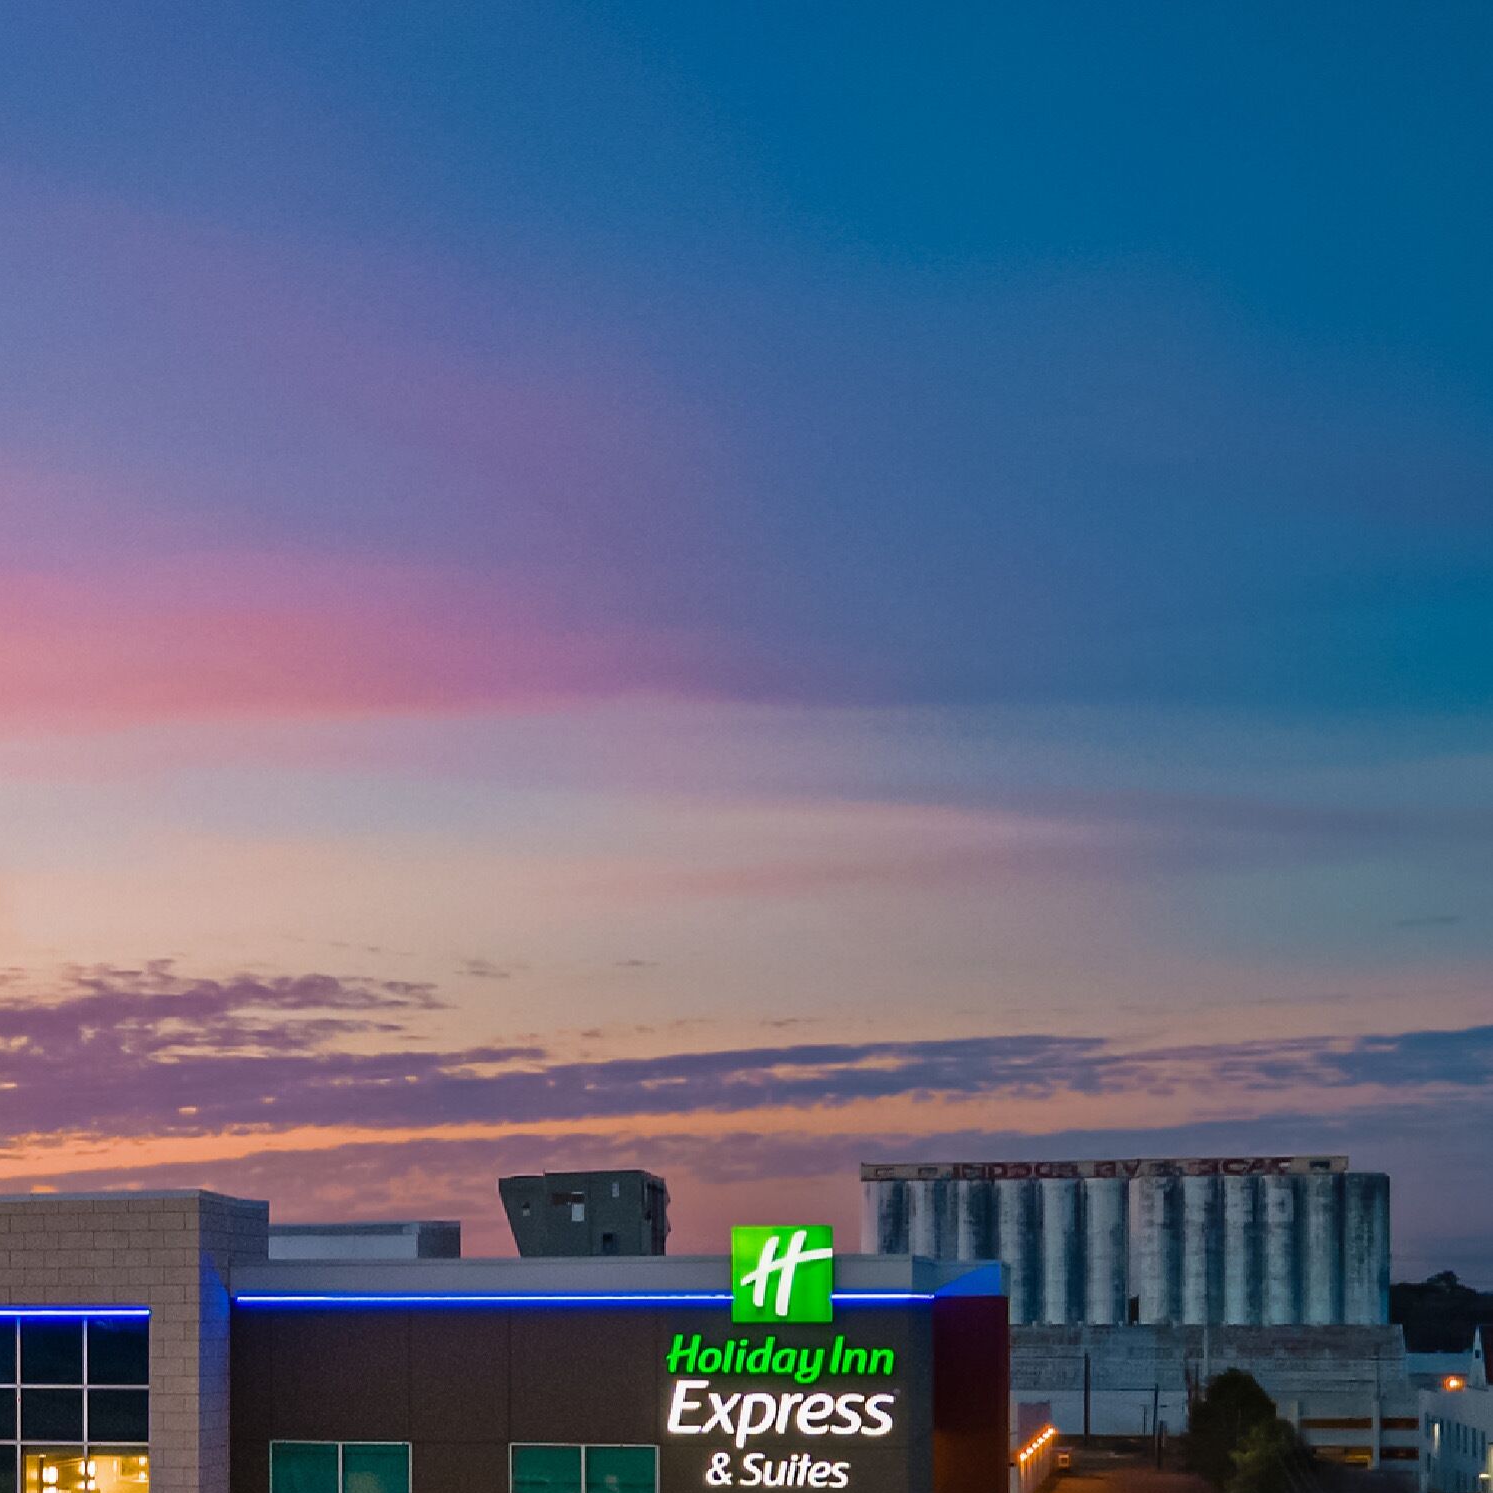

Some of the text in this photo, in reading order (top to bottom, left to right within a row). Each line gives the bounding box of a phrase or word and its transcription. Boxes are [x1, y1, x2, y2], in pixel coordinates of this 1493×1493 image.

[666, 1334, 895, 1384] Holiday Inn
[667, 1379, 895, 1449] Express
[706, 1452, 851, 1489] & Suites
